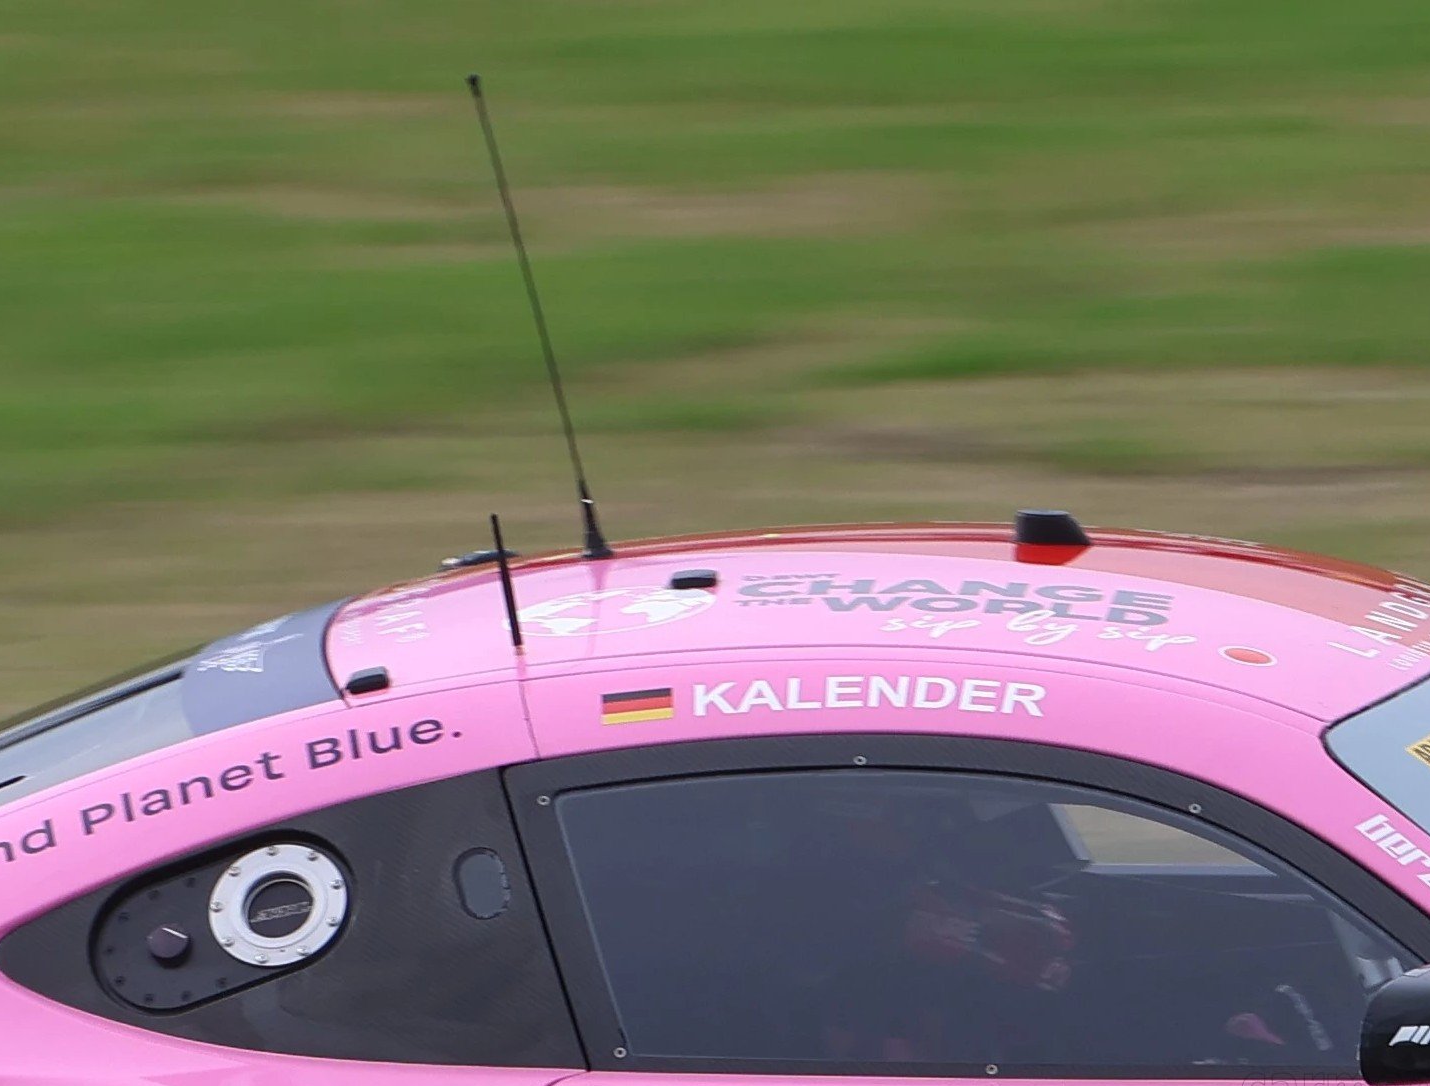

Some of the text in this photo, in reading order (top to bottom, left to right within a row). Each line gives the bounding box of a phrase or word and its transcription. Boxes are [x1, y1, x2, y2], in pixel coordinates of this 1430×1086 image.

[738, 577, 1177, 611] CHANGE
[820, 596, 1172, 628] WORLD
[879, 610, 1199, 652] sip by sip
[691, 674, 1048, 719] KALENDER
[78, 750, 287, 838] Planet
[305, 716, 465, 771] Blue.
